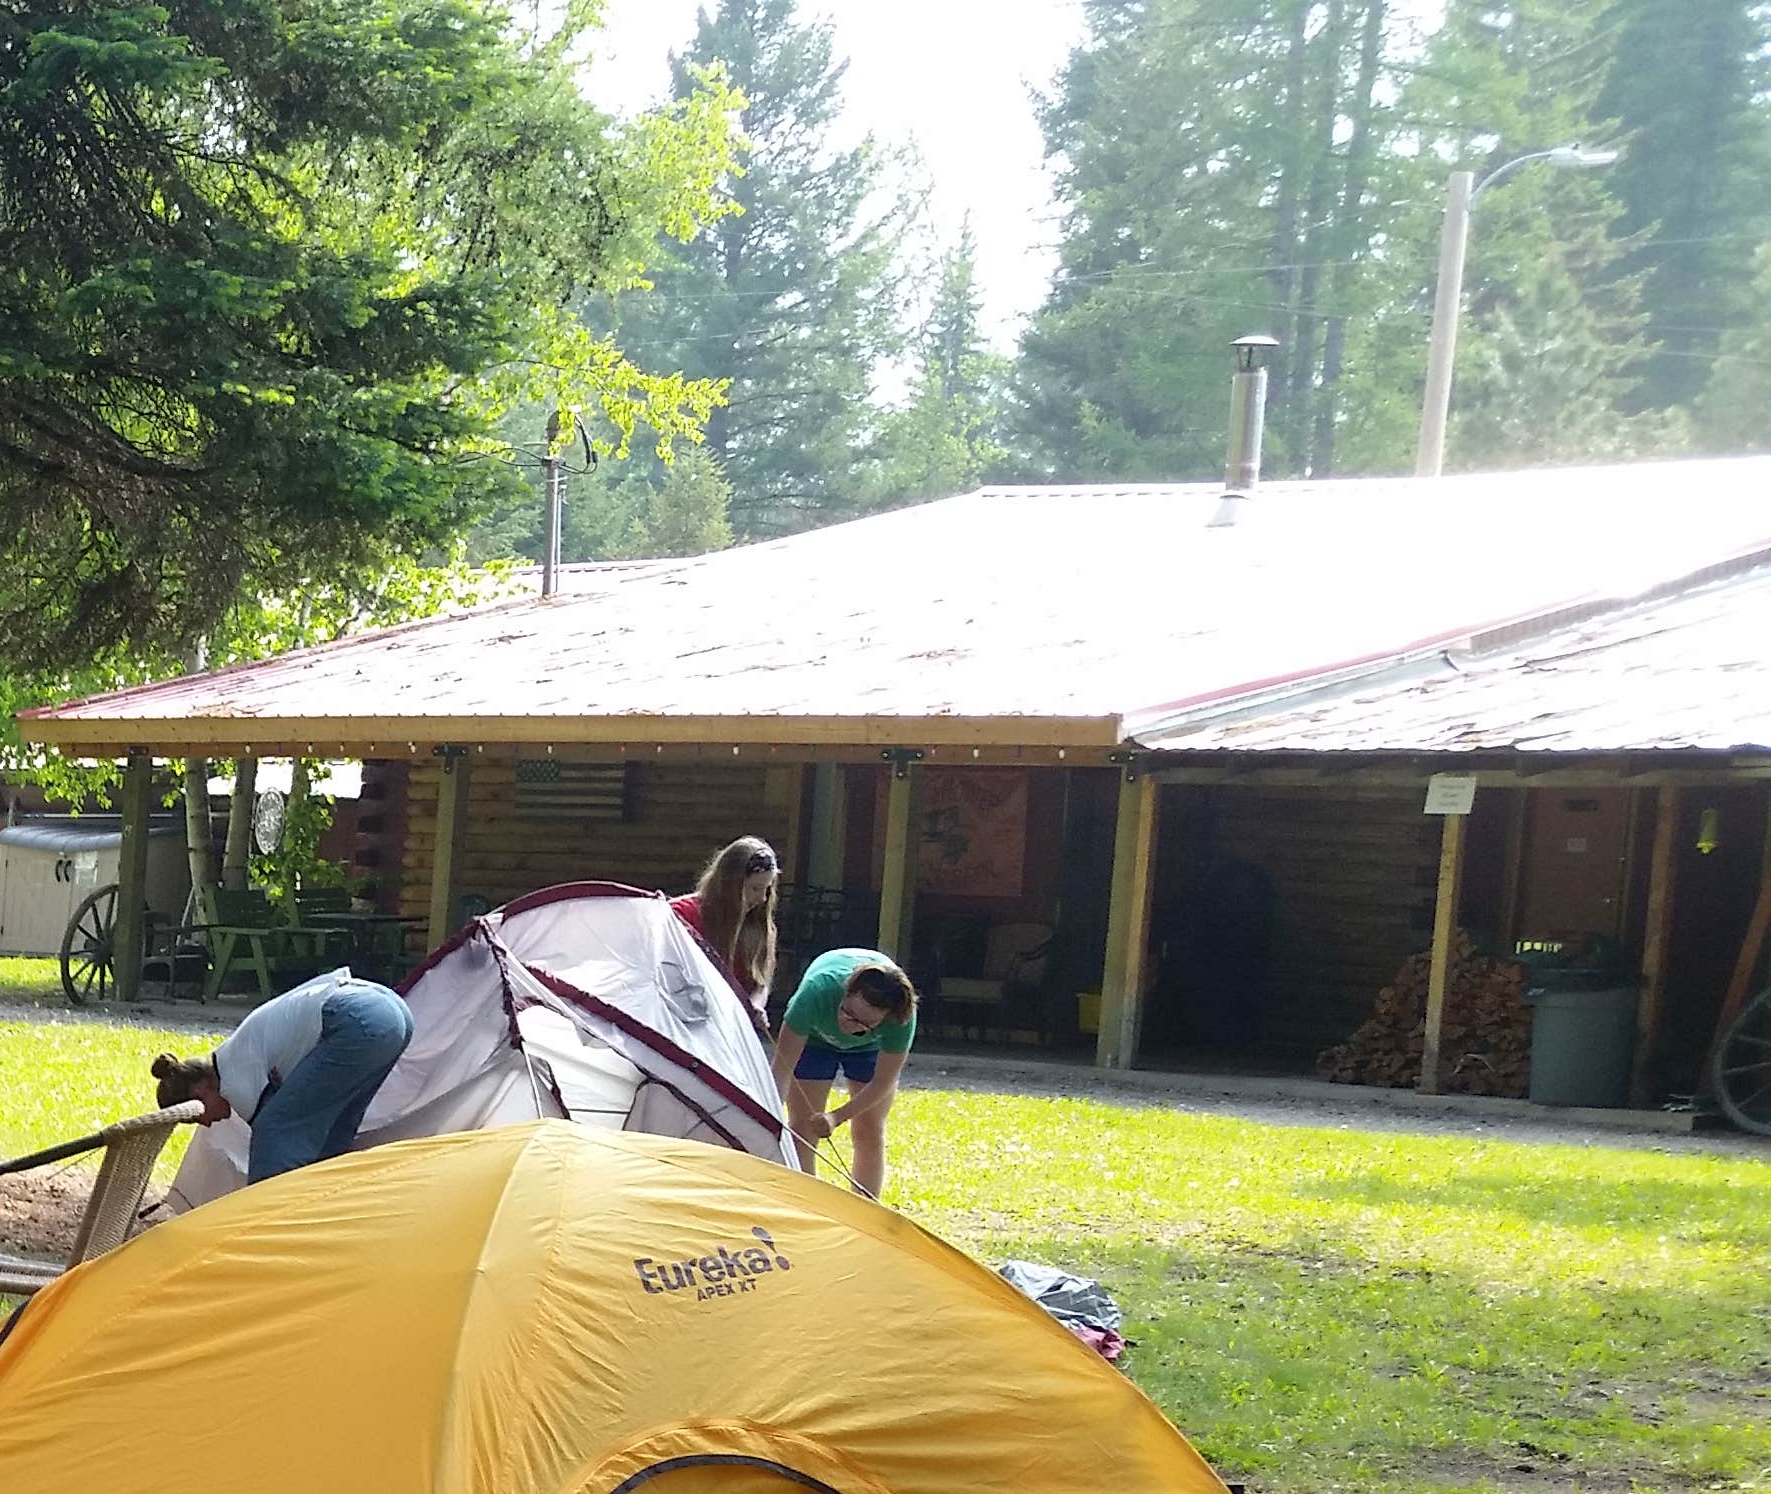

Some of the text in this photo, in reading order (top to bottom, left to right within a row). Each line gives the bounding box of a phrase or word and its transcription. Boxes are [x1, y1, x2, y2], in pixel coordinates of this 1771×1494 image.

[634, 1226, 791, 1294] Eureka!
[697, 1278, 757, 1301] APEX XT
